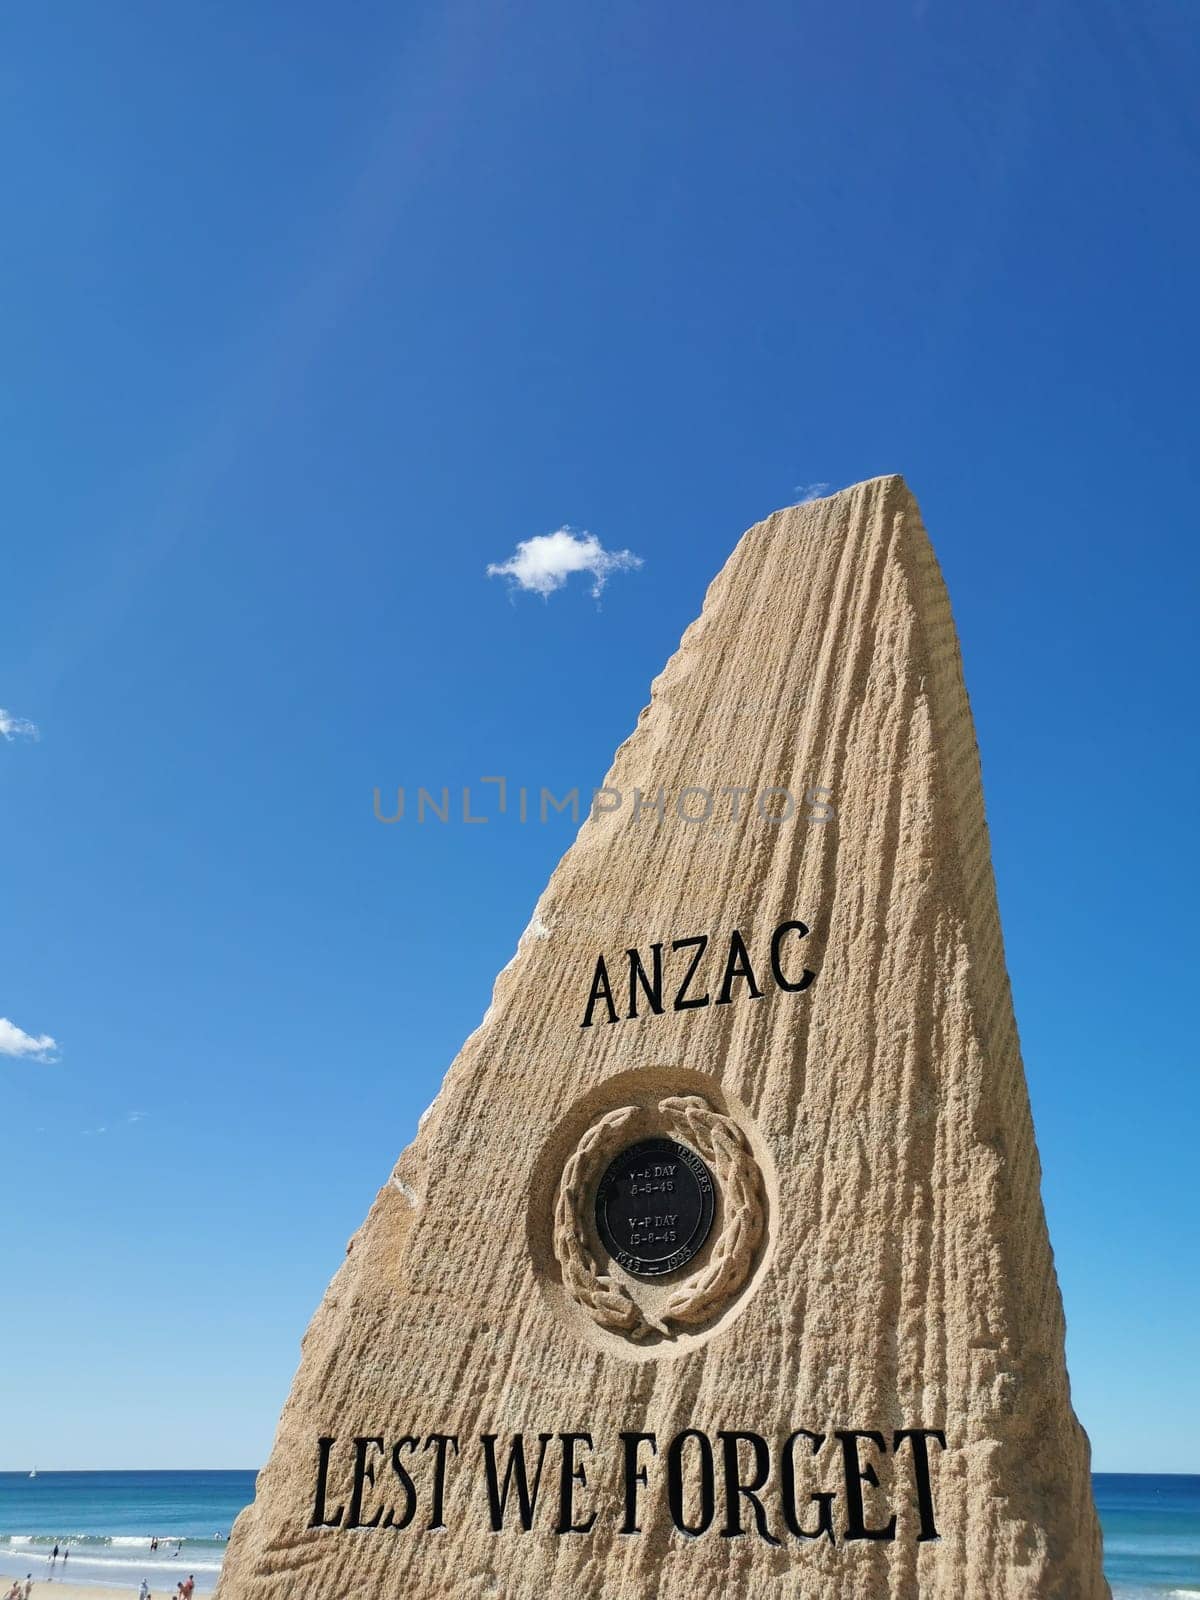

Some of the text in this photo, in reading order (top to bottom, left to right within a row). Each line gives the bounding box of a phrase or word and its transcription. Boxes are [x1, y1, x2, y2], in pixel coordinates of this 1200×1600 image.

[580, 920, 816, 1027] ANZAC
[654, 1165, 677, 1177] DAY
[628, 1214, 678, 1229] V-P DAY
[630, 1231, 677, 1245] 15-8-45
[308, 1428, 947, 1547] LEST WE FORGET
